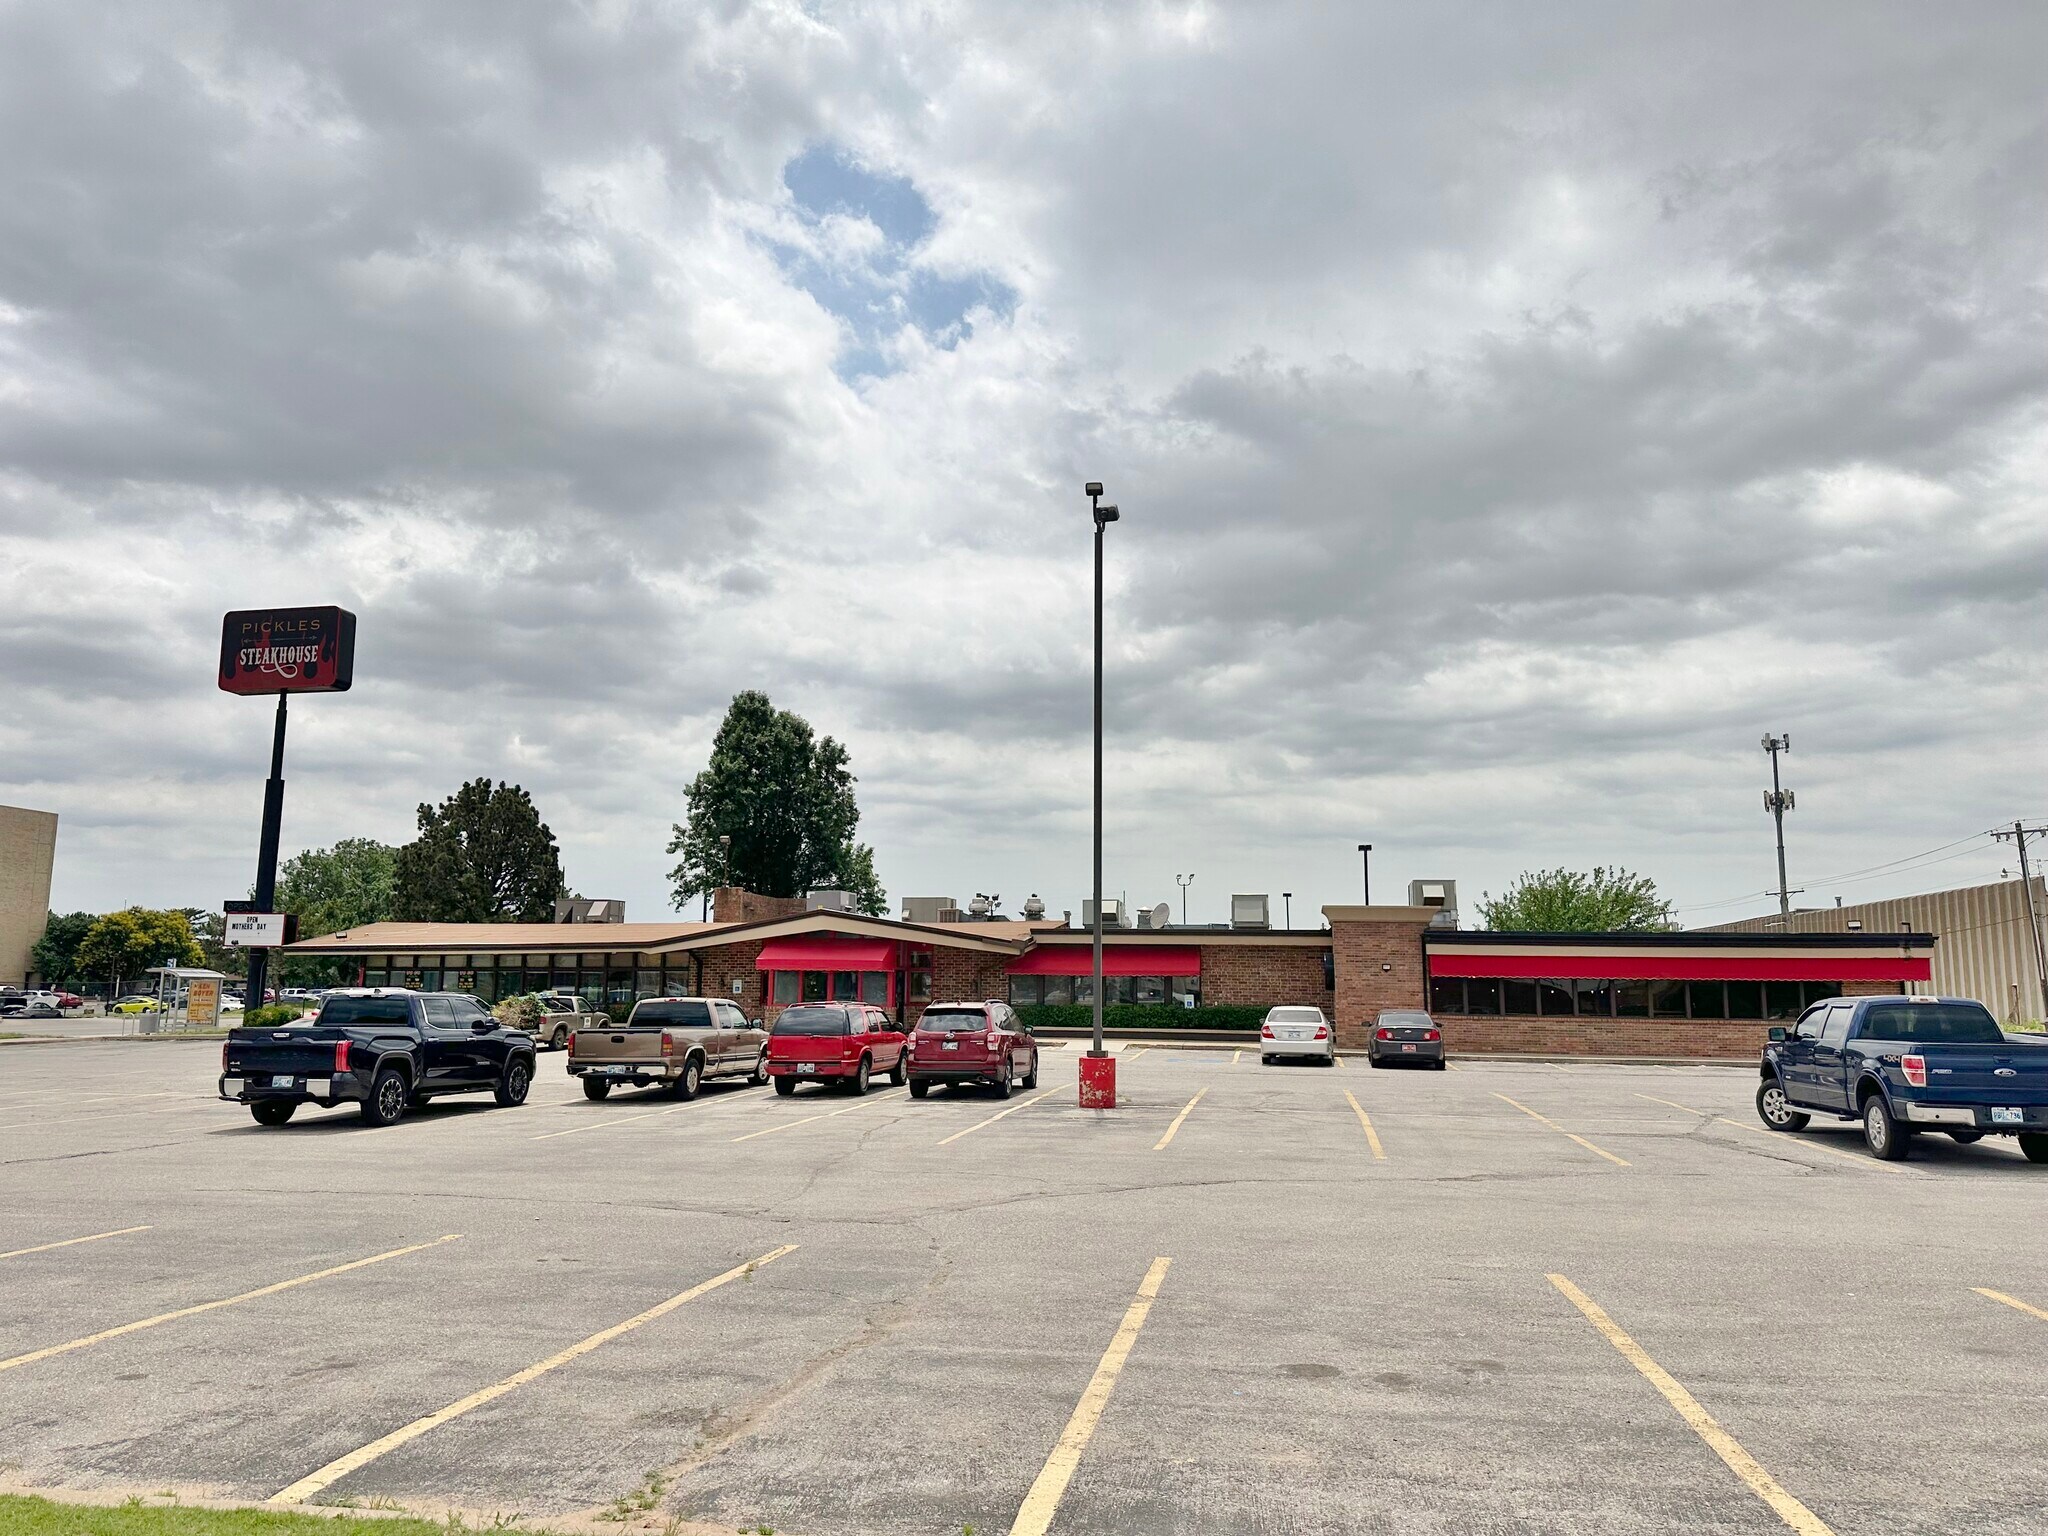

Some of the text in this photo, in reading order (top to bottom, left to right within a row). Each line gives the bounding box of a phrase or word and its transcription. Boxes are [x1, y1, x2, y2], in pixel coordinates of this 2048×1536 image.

[242, 619, 321, 634] PICKLES
[240, 645, 319, 678] STEAKHOUSE
[227, 903, 250, 911] OPEN
